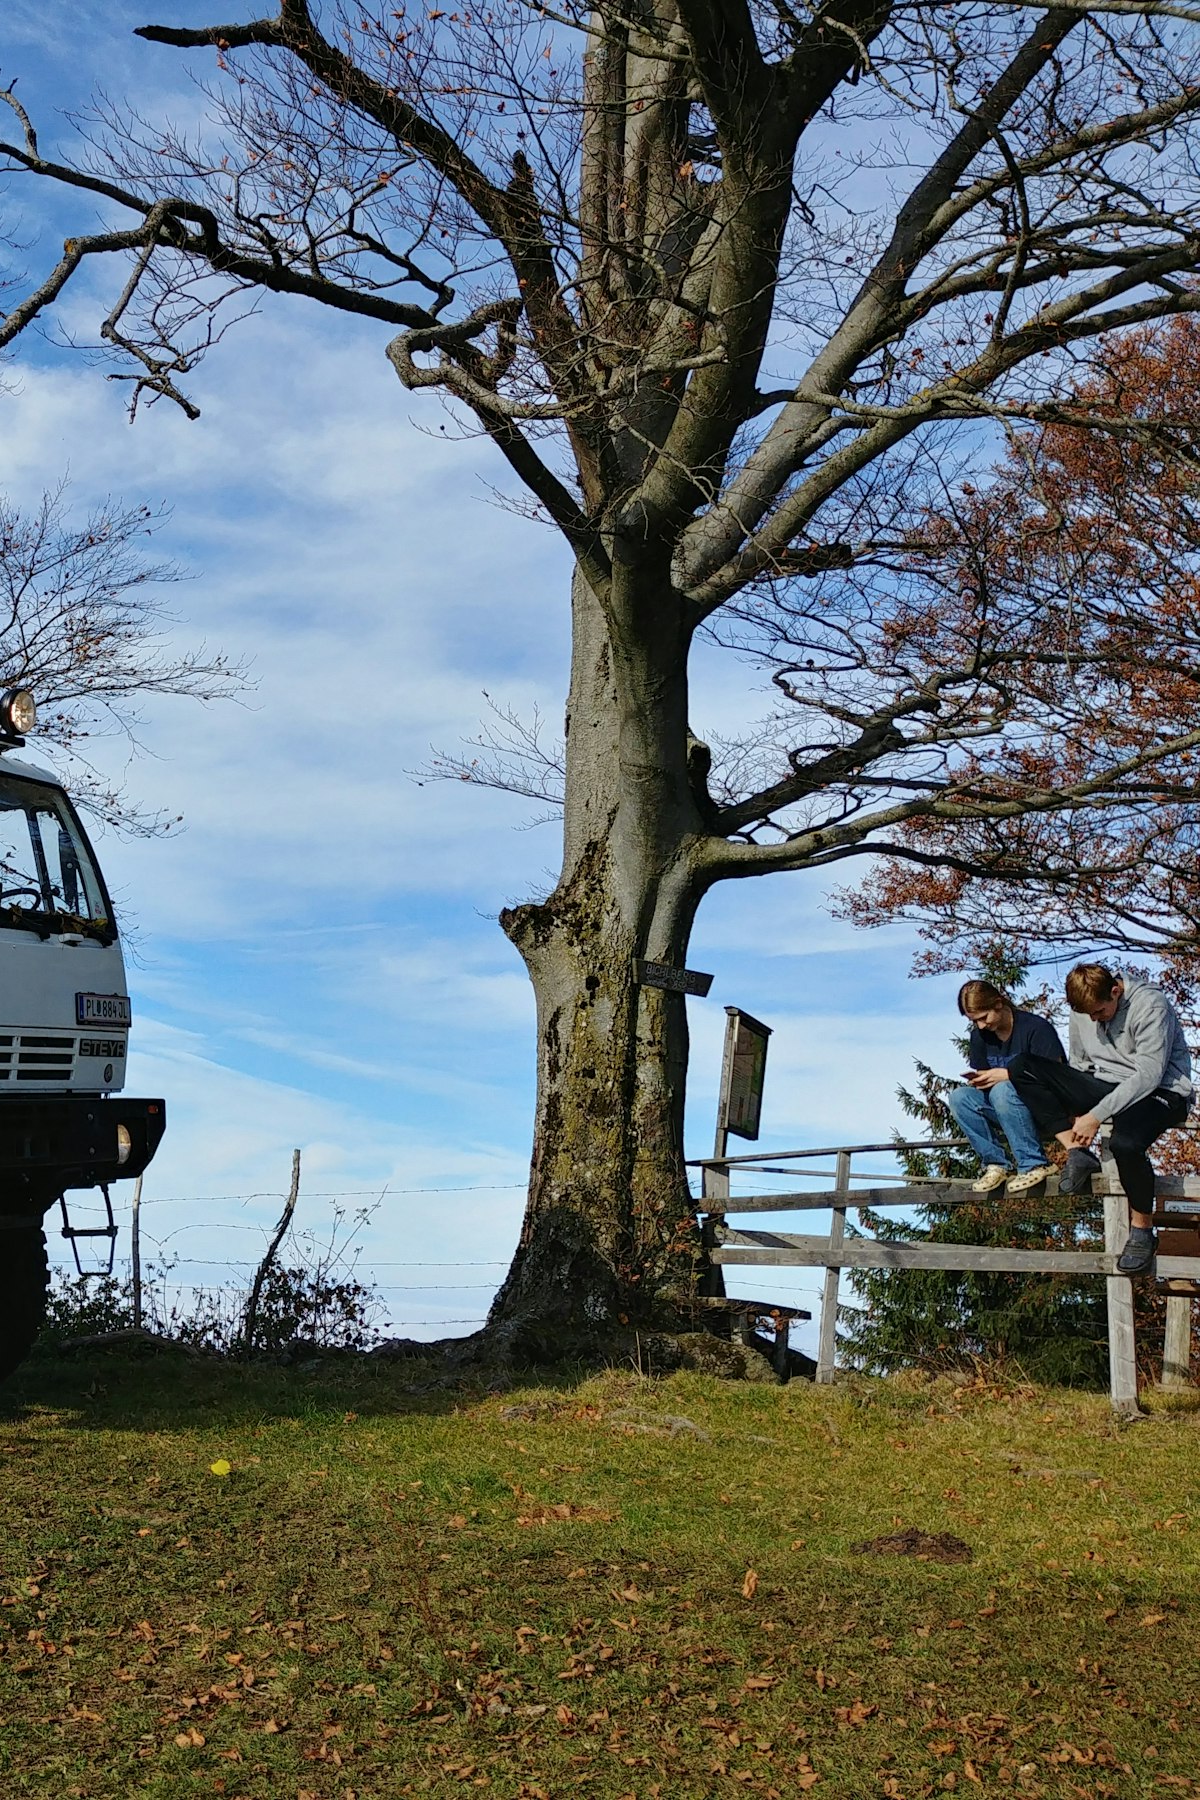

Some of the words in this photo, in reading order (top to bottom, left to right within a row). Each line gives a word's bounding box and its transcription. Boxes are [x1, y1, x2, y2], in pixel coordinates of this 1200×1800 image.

[646, 964, 696, 983] BICHLBERG
[86, 999, 97, 1016] PL
[102, 1000, 117, 1018] 884
[81, 1040, 125, 1057] STEYR
